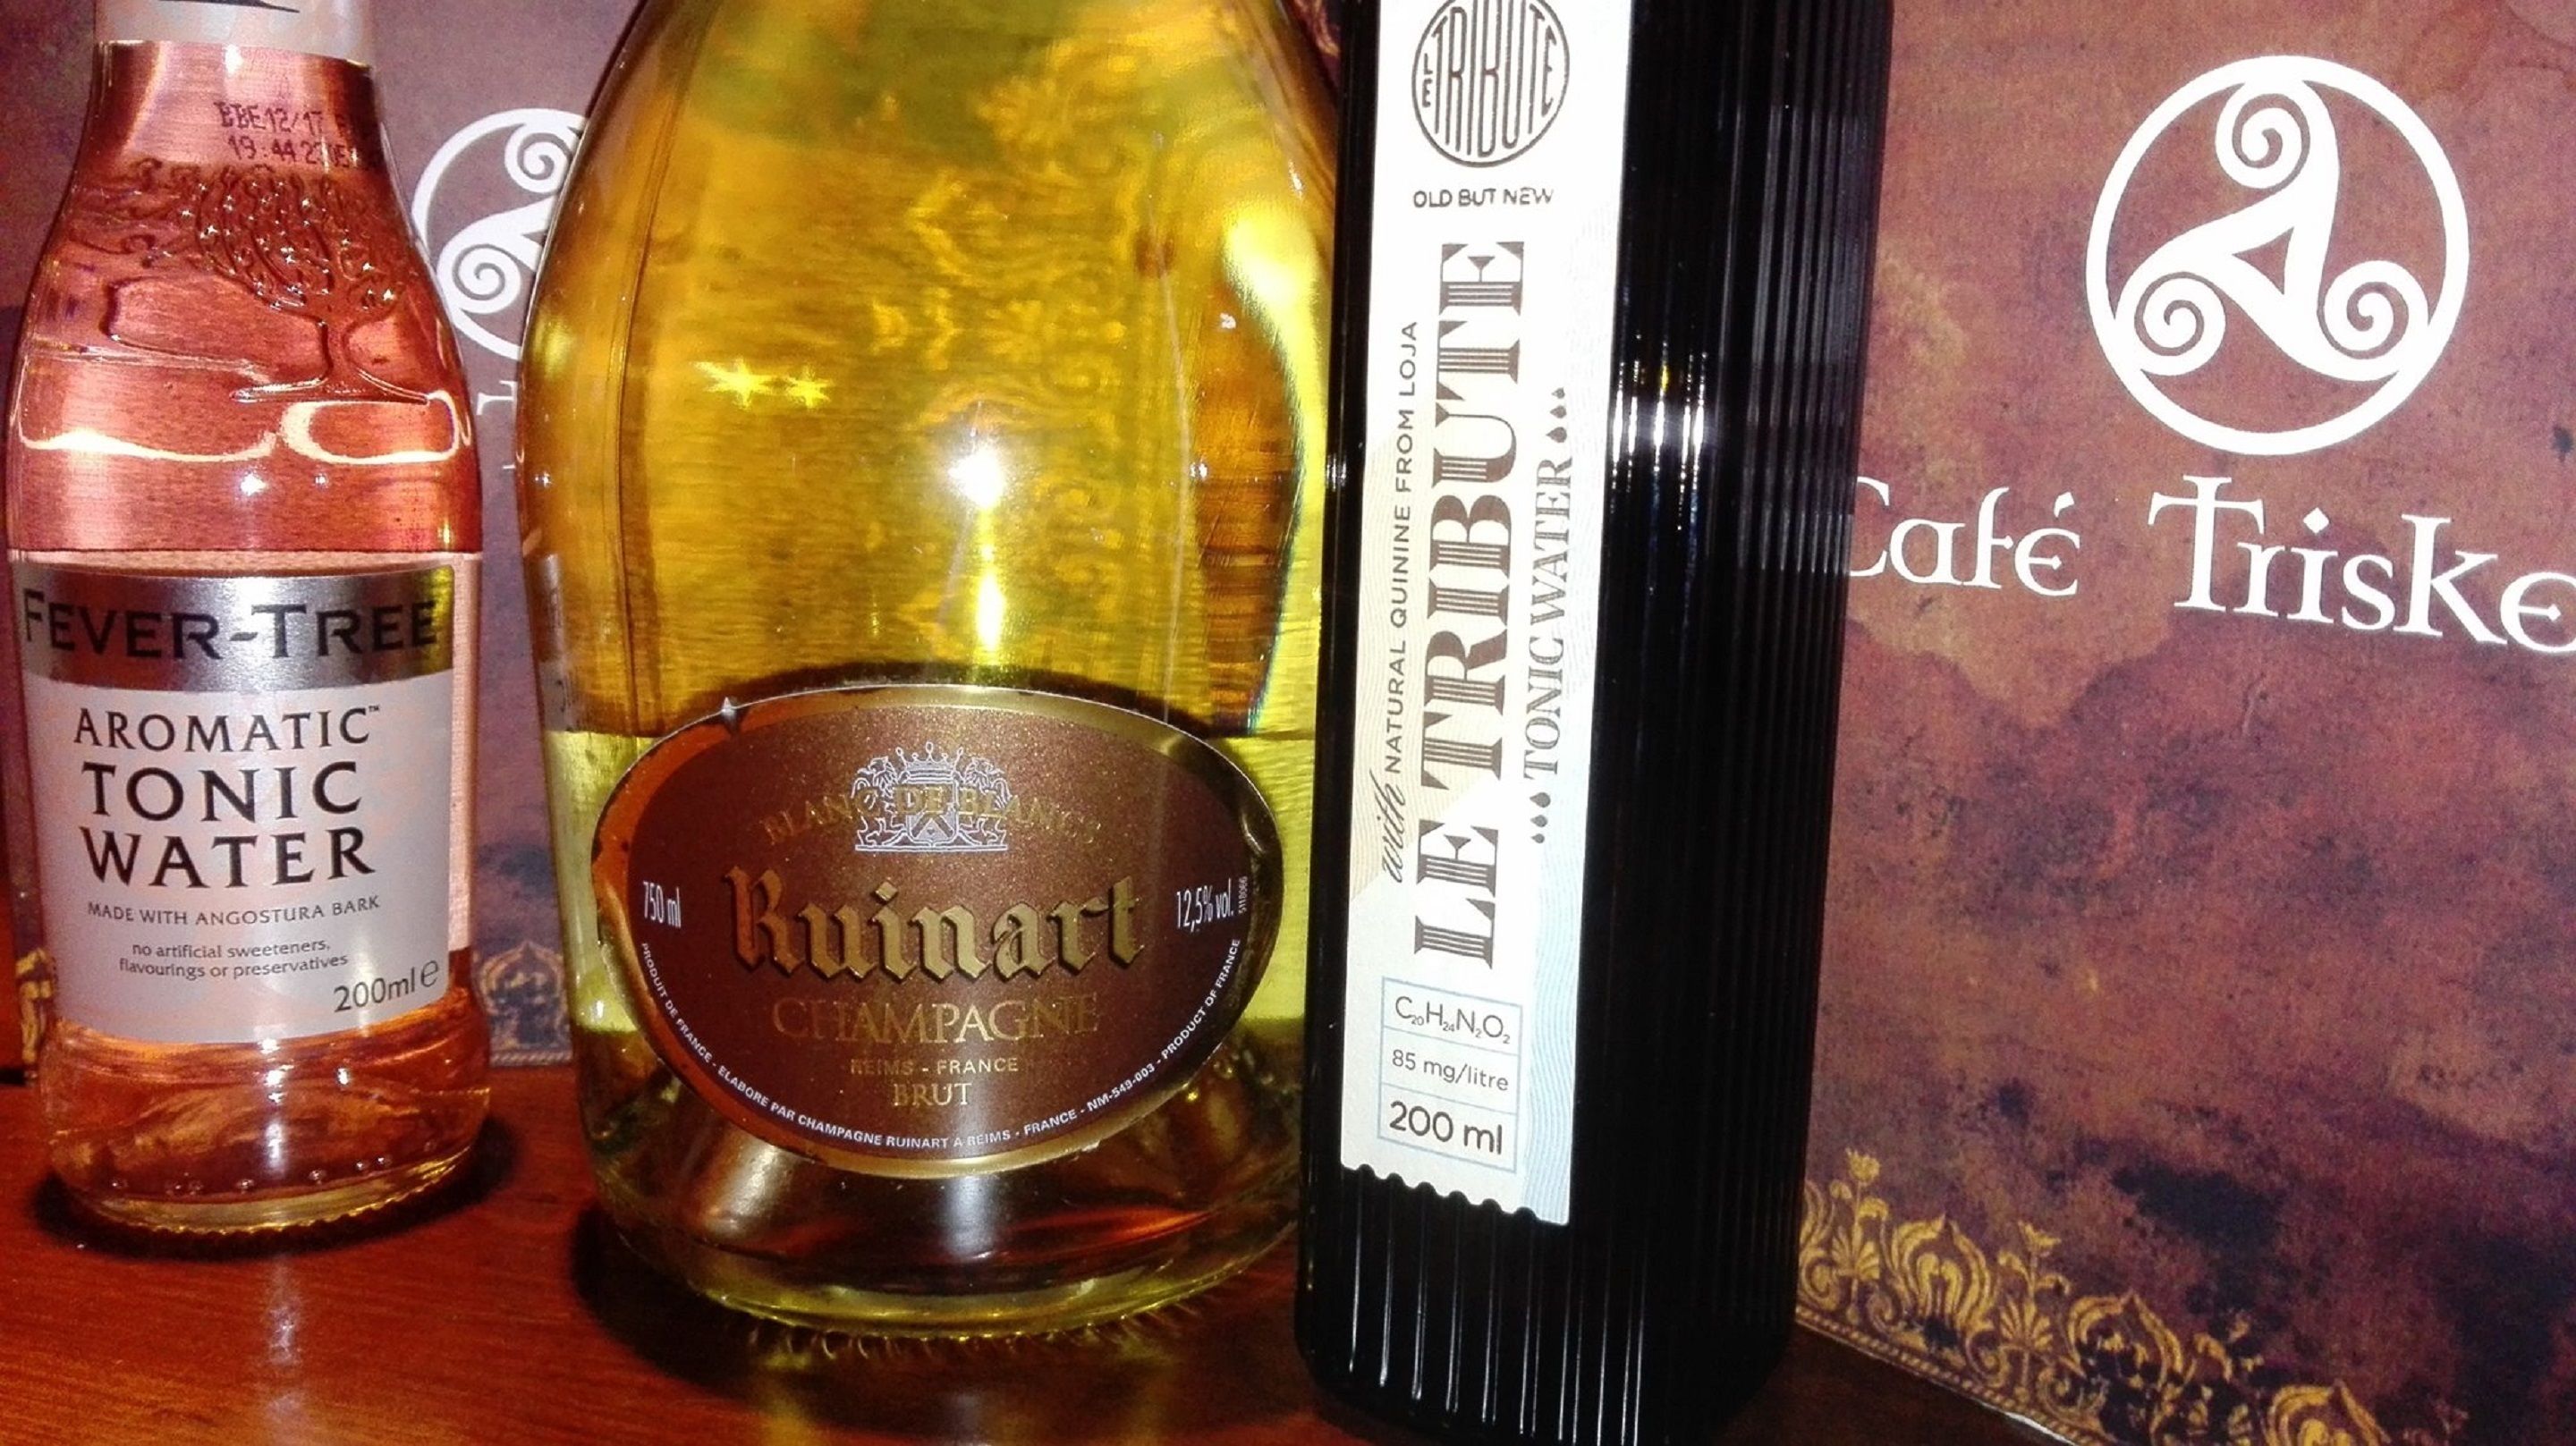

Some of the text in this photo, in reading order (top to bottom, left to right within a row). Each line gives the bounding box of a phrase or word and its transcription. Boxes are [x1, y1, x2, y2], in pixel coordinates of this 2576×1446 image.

[1413, 187, 1554, 207] OLD BUT NEW
[1849, 474, 2576, 654] Café Triske
[22, 588, 438, 660] FEVER-TREE
[1368, 322, 1418, 884] with NATURAL QUININE FROM LOJA
[1414, 241, 1525, 969] LE TRIBUTE
[1523, 457, 1572, 781] TONIC WATER
[81, 760, 362, 822] TONIC
[80, 825, 376, 889] WATER
[88, 895, 379, 926] MADE WITH ANGOSTURA BARK
[643, 881, 682, 929] 750 ml
[723, 865, 1145, 982] Ruinart
[1176, 884, 1213, 932] 12,5%
[120, 953, 349, 980] flavourings or preservatives
[132, 943, 152, 957] no
[156, 943, 222, 960] artificial
[641, 943, 668, 998] PRODUIT
[665, 1000, 680, 1019] DE
[676, 1018, 713, 1063] FRANCE
[717, 1065, 770, 1107] ELABORE
[770, 1102, 796, 1120] PAR
[798, 1115, 882, 1146] CHAMPAGNE
[886, 1137, 949, 1149] RUINART
[967, 1130, 1011, 1146] REIMS
[1023, 1109, 1078, 1136] FRANCE
[1161, 1008, 1208, 1061] PRODUCT
[1204, 989, 1218, 1008] OF
[1215, 939, 1241, 988] FRANCE
[773, 992, 1098, 1044] CHAMPAGNE
[937, 1058, 1019, 1075] FRANCE
[1392, 1049, 1509, 1092] 85 mg/litre
[894, 1082, 972, 1107] BRUT
[1389, 1101, 1503, 1155] 200 ml
